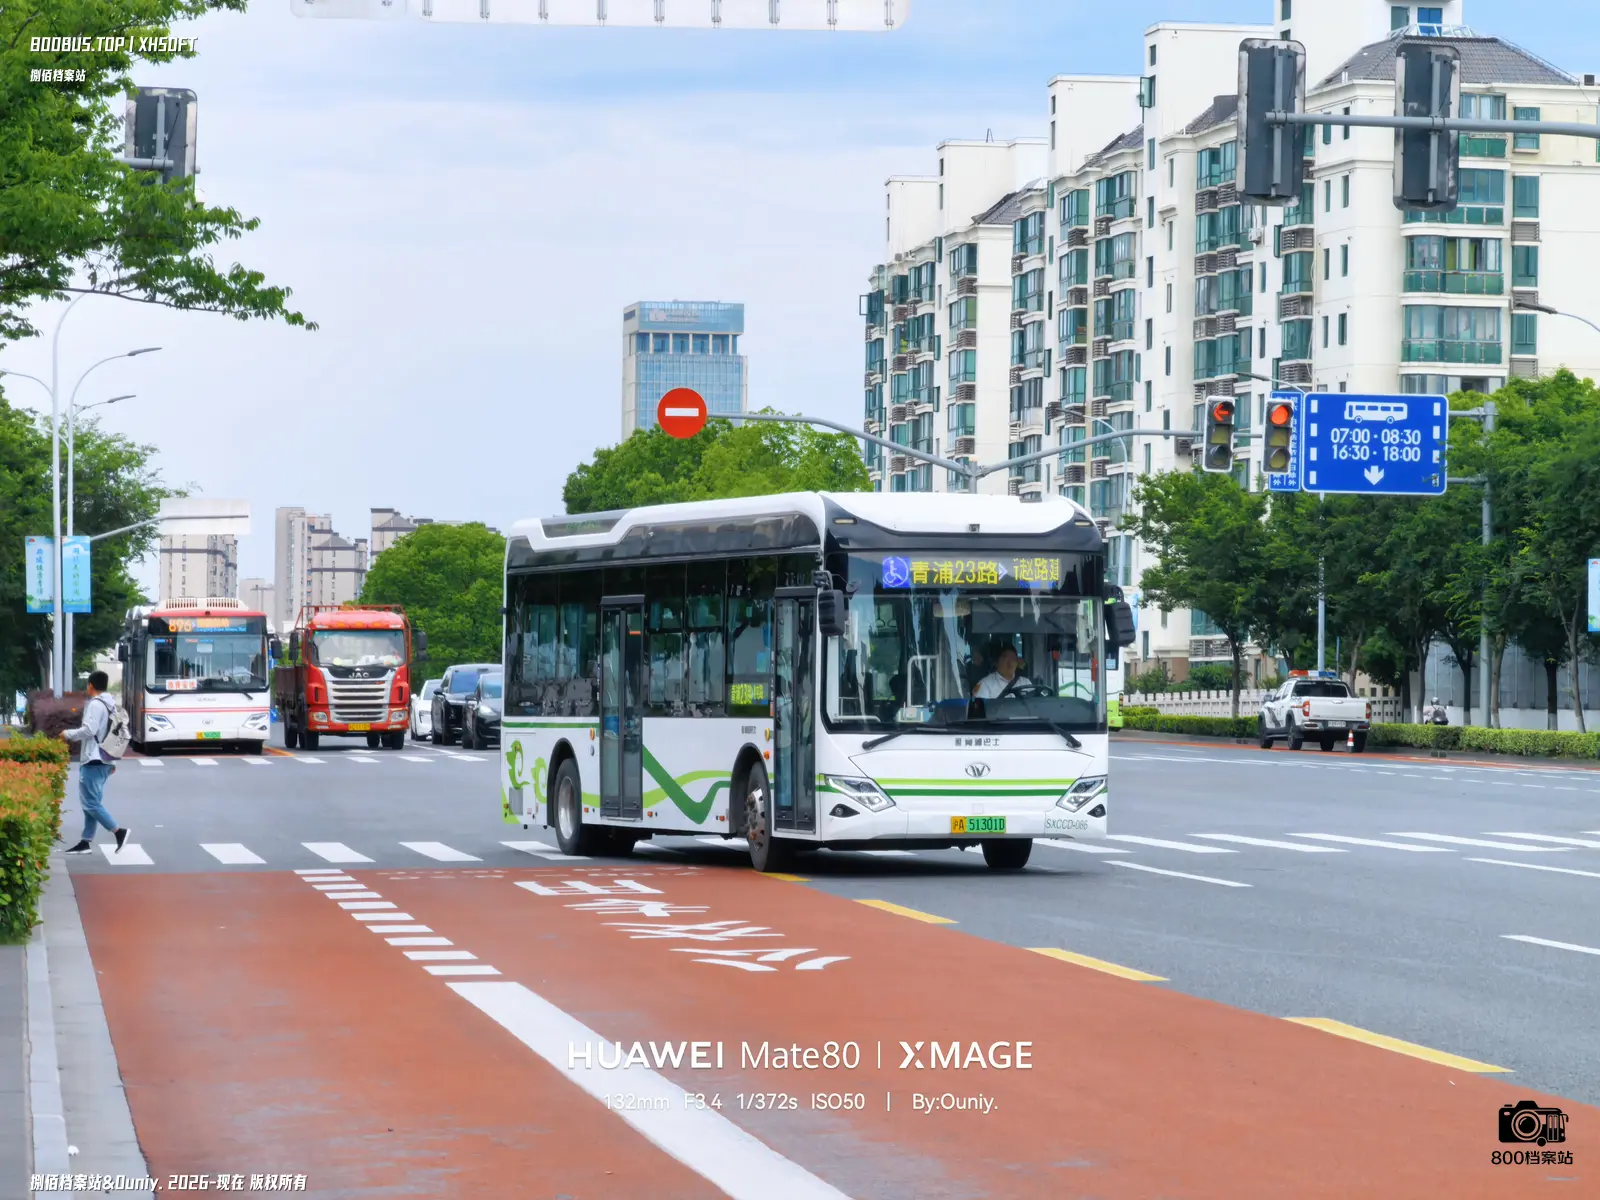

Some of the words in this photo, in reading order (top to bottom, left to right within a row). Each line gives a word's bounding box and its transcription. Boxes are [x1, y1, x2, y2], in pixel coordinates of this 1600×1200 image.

[1330, 428, 1371, 444] 07:00
[1381, 429, 1422, 445] 08:30
[1332, 445, 1370, 460] 16:30
[1383, 446, 1422, 462] 18:00
[910, 561, 999, 585] 青浦23路
[168, 618, 193, 633] 896
[969, 818, 1005, 832] 51301D
